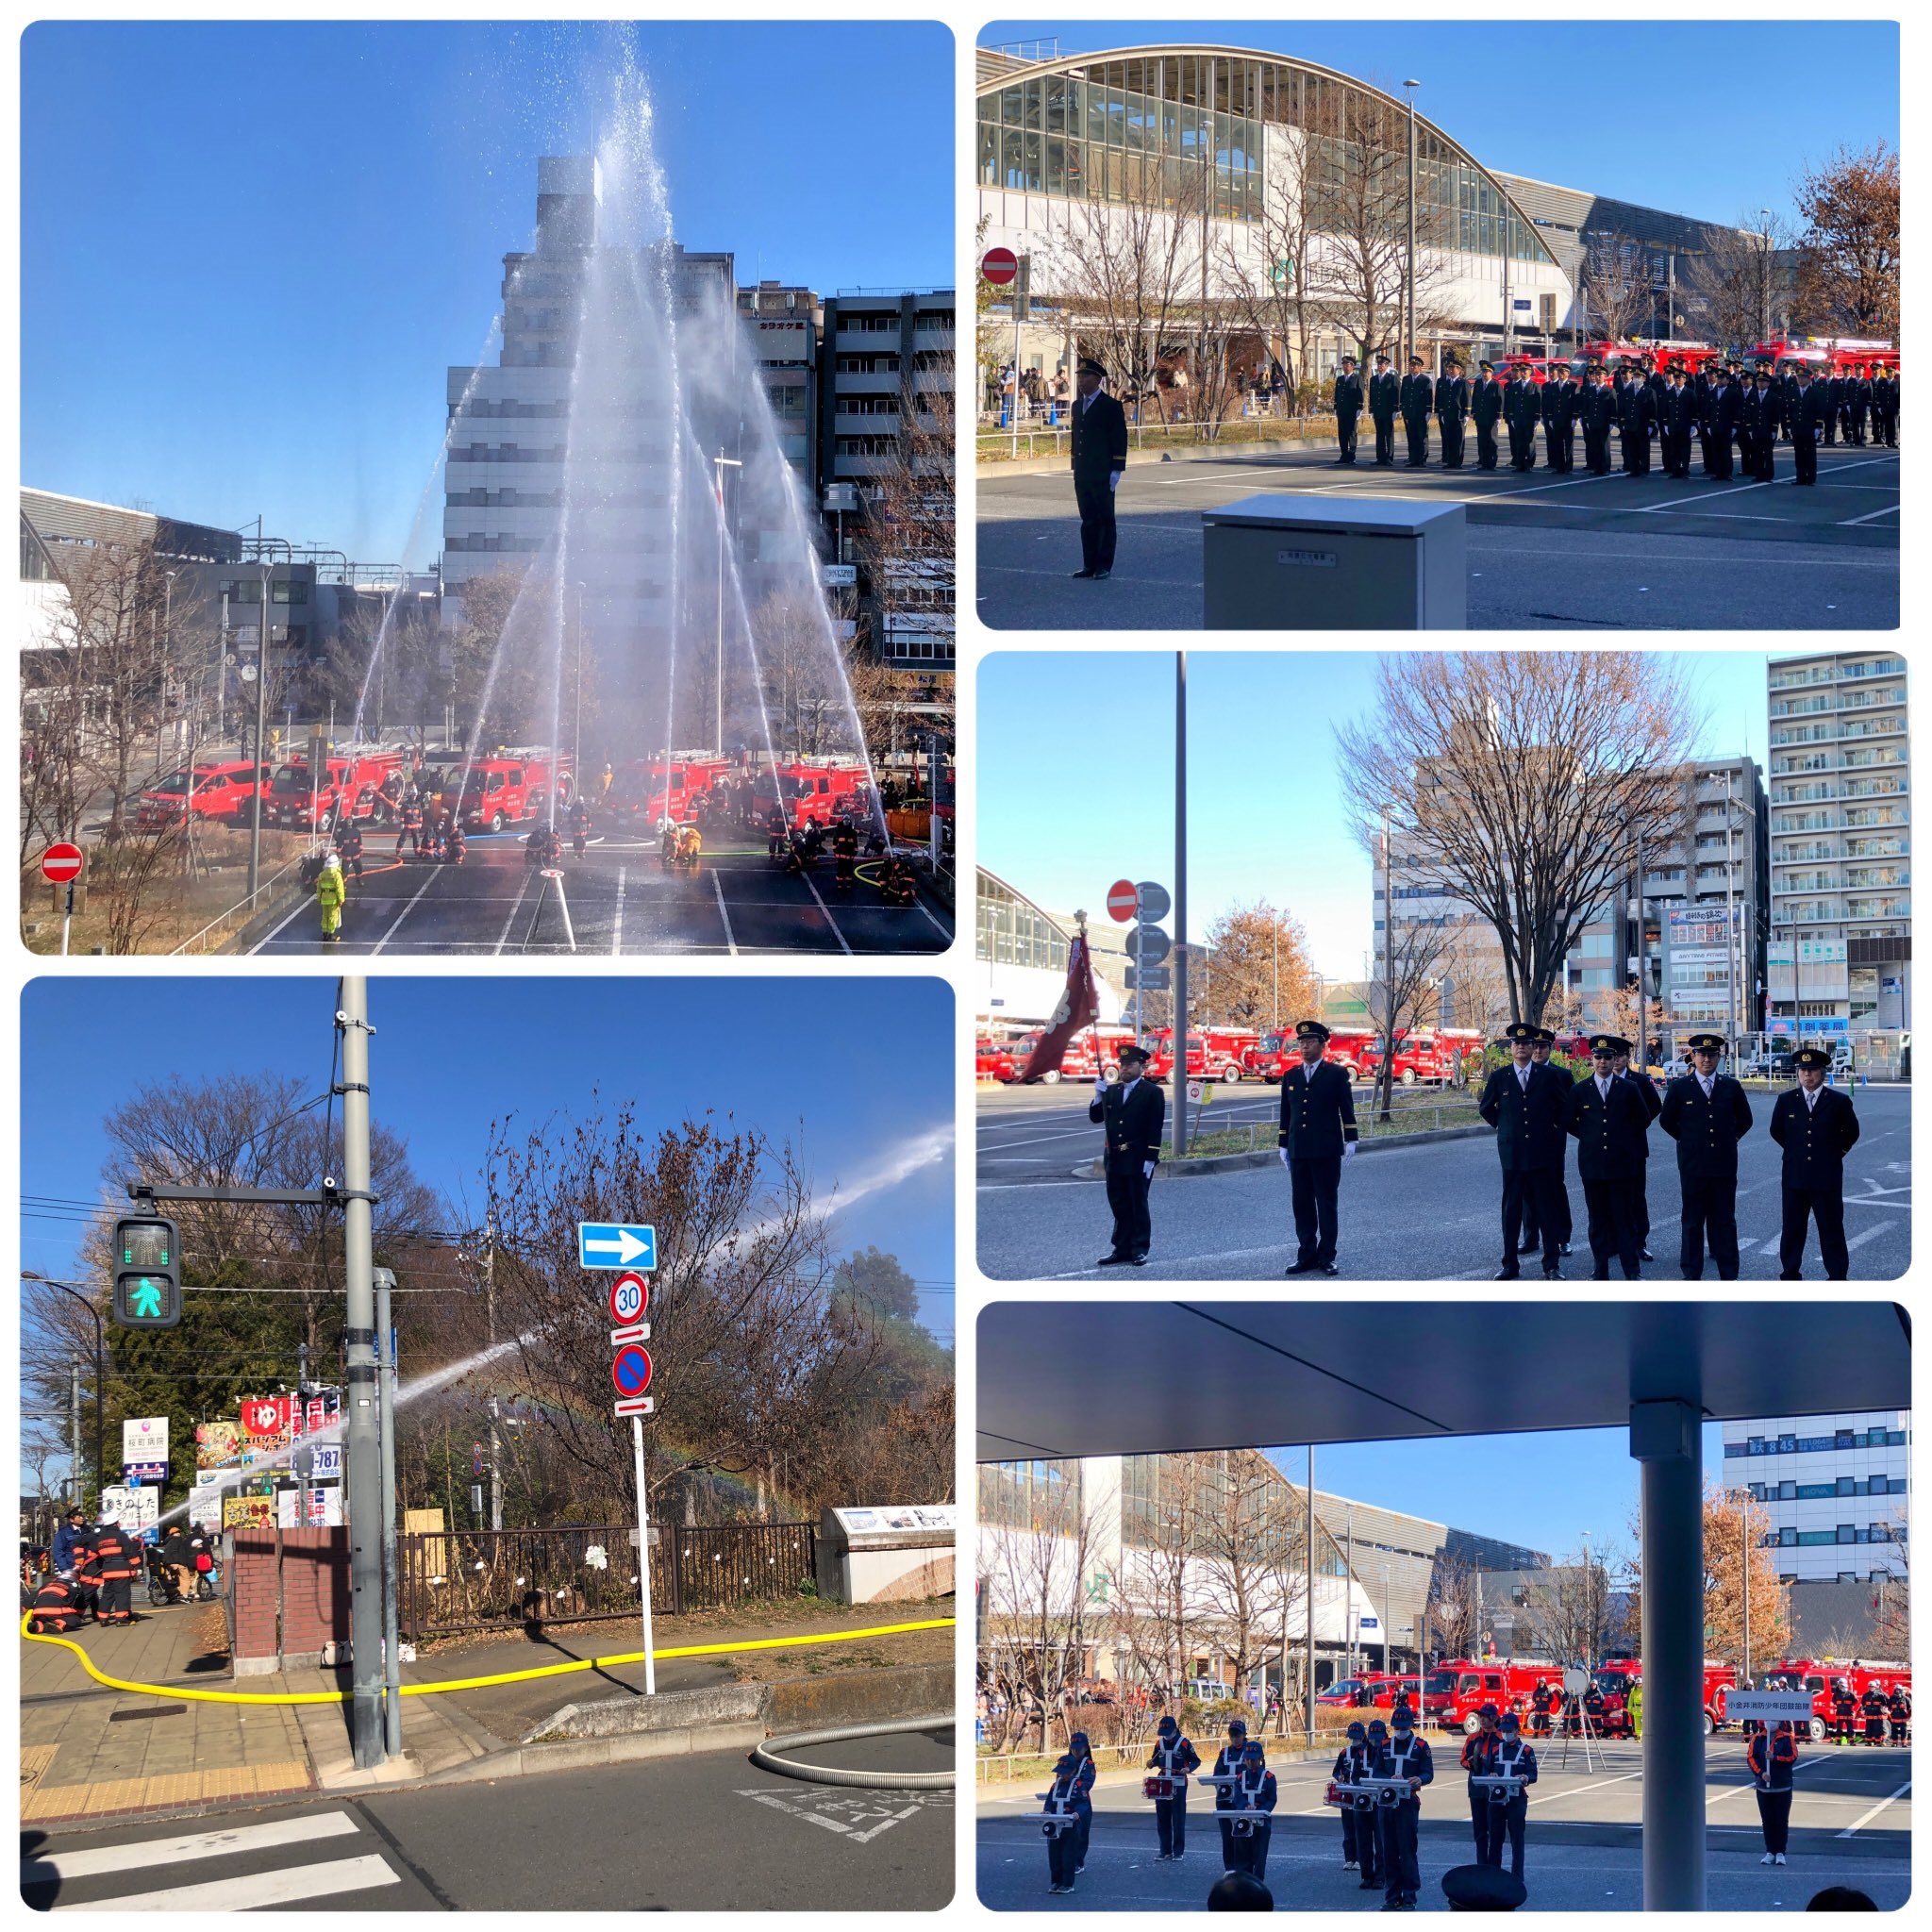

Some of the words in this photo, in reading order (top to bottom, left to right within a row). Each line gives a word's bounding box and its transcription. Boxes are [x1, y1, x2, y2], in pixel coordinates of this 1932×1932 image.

[618, 1287, 640, 1312] 30
[258, 1404, 277, 1429] ゆ
[127, 1437, 164, 1447] 桜町病院
[1803, 1488, 1829, 1496] NOVA
[116, 1497, 156, 1510] きのした
[120, 1510, 156, 1520] クリニック
[1086, 1574, 1109, 1595] JR
[1728, 1701, 1810, 1710] 小金井消防少年団鼓笛隊
